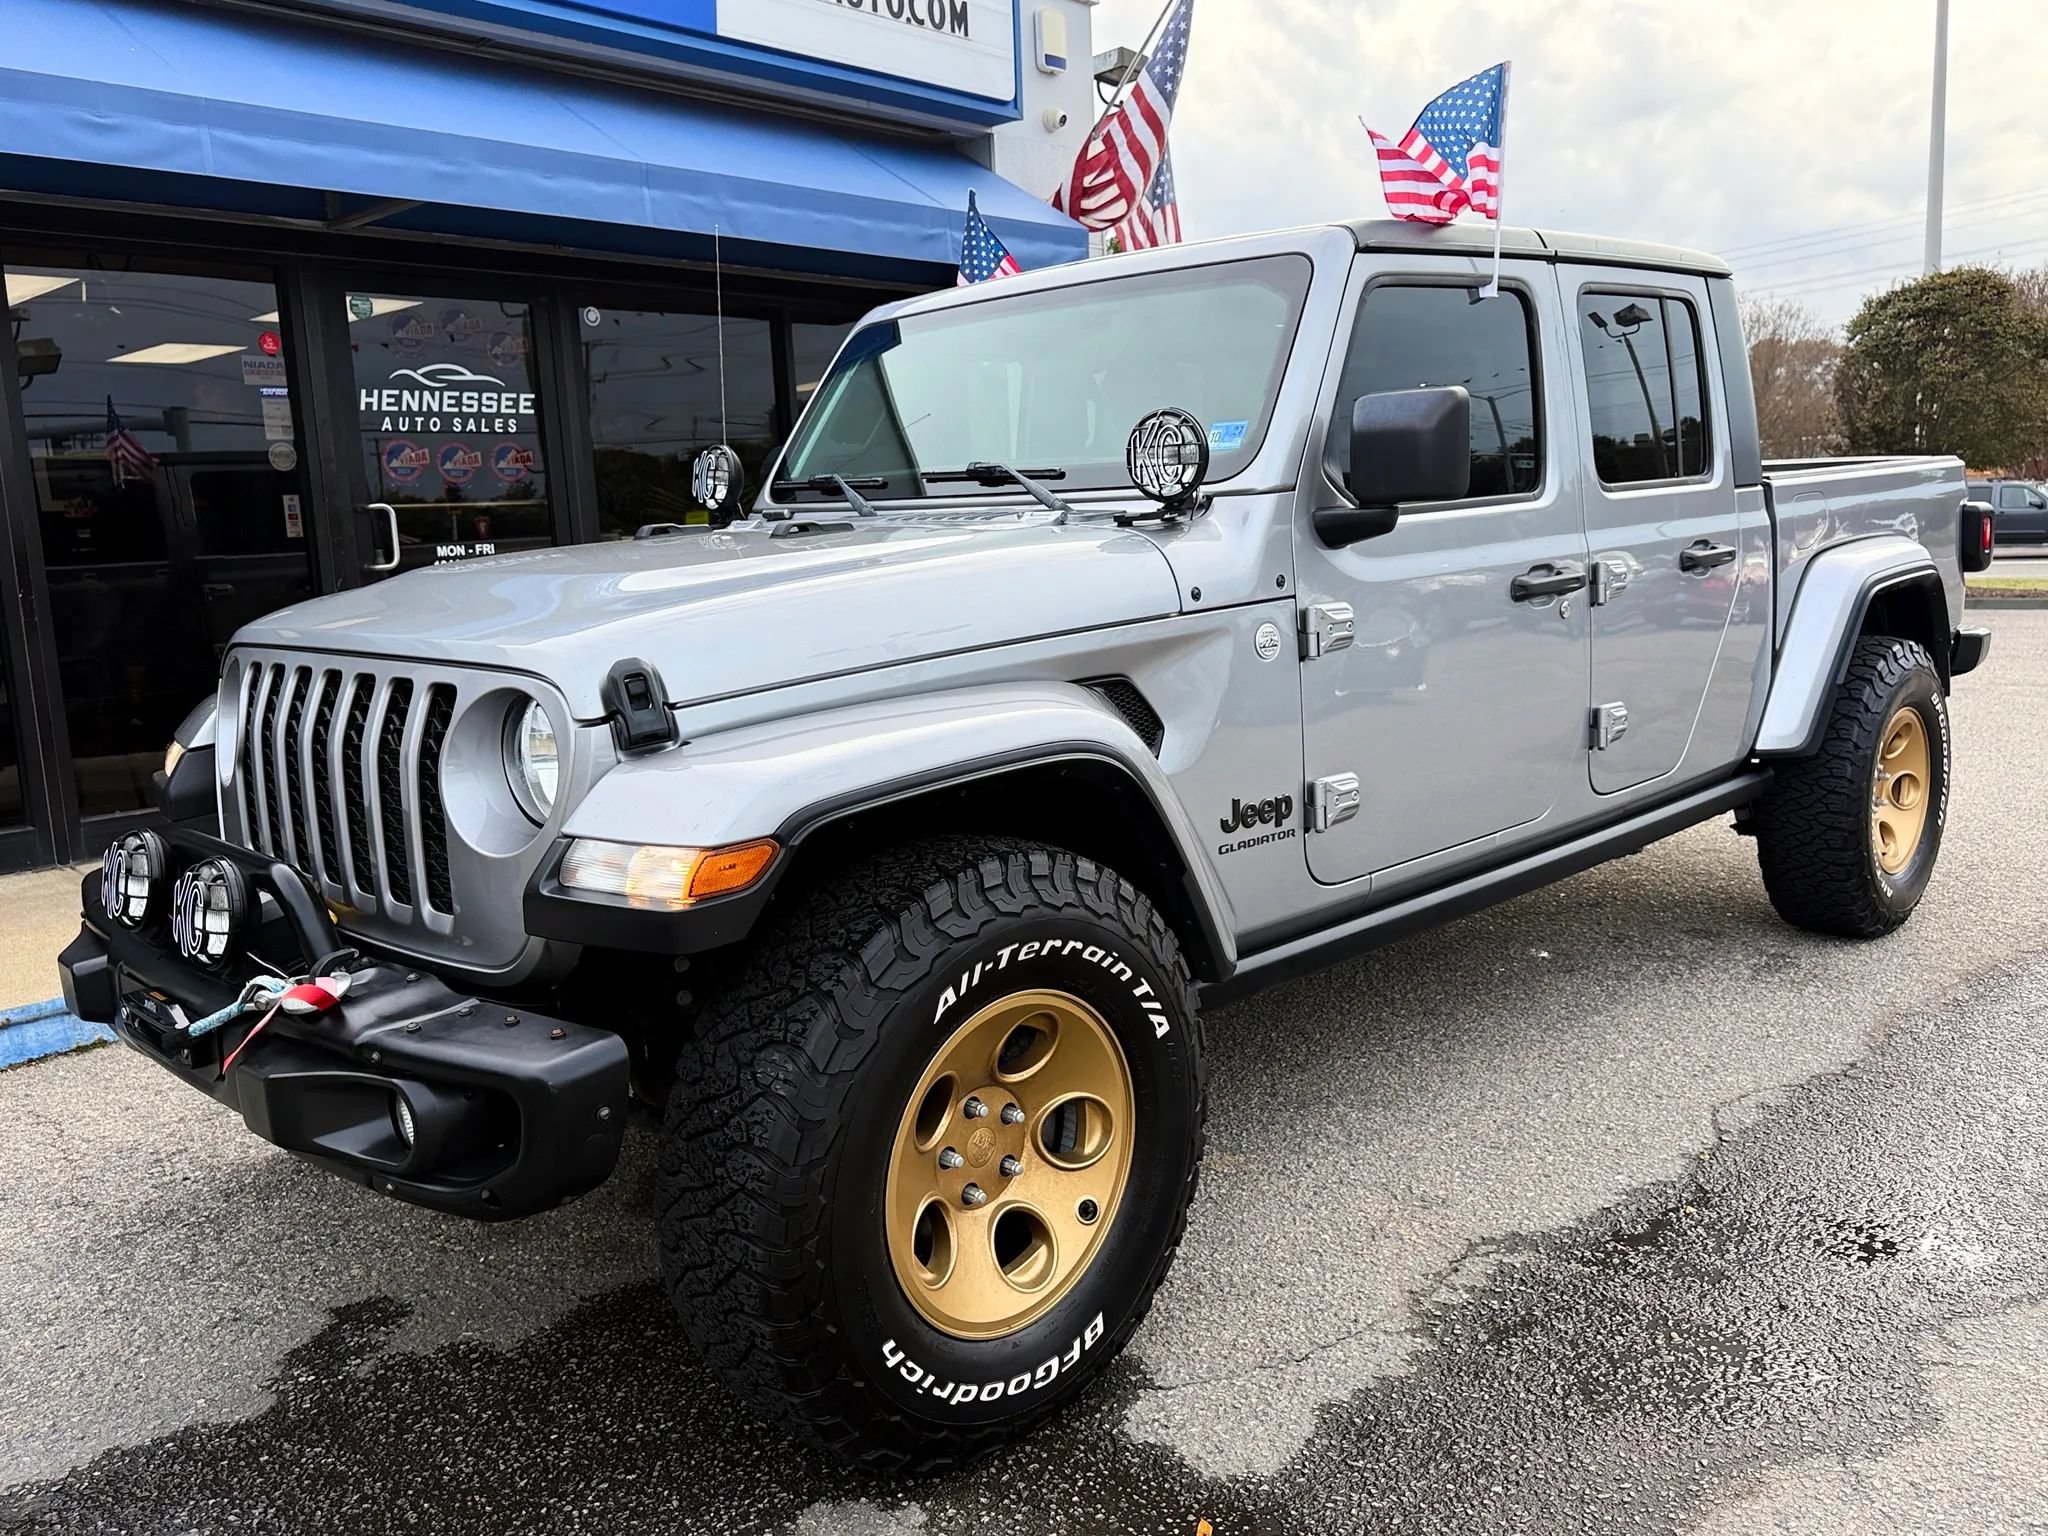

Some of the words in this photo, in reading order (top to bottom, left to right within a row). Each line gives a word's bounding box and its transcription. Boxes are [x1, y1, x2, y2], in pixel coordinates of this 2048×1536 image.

[406, 325, 432, 336] VIADA
[243, 360, 285, 369] NIADA
[360, 389, 535, 414] HENNESSEE
[381, 416, 441, 432] AUTO
[453, 417, 517, 433] SALES
[1210, 431, 1222, 443] 10
[400, 451, 429, 465] VIADA
[453, 454, 480, 466] VIADA
[506, 453, 531, 465] VIADA
[1131, 420, 1183, 490] KC
[692, 450, 716, 503] KC
[436, 544, 466, 557] MON
[475, 543, 495, 555] FRI
[1930, 692, 1950, 828] BFGoodrich
[1220, 793, 1293, 833] Jeep
[1218, 829, 1296, 855] GLADIATOR
[101, 842, 126, 919] KC
[173, 872, 204, 957] KC
[933, 938, 1134, 1025] All-Terrain
[1132, 976, 1171, 1039] T/A
[882, 1311, 1105, 1406] BFGoodrich
